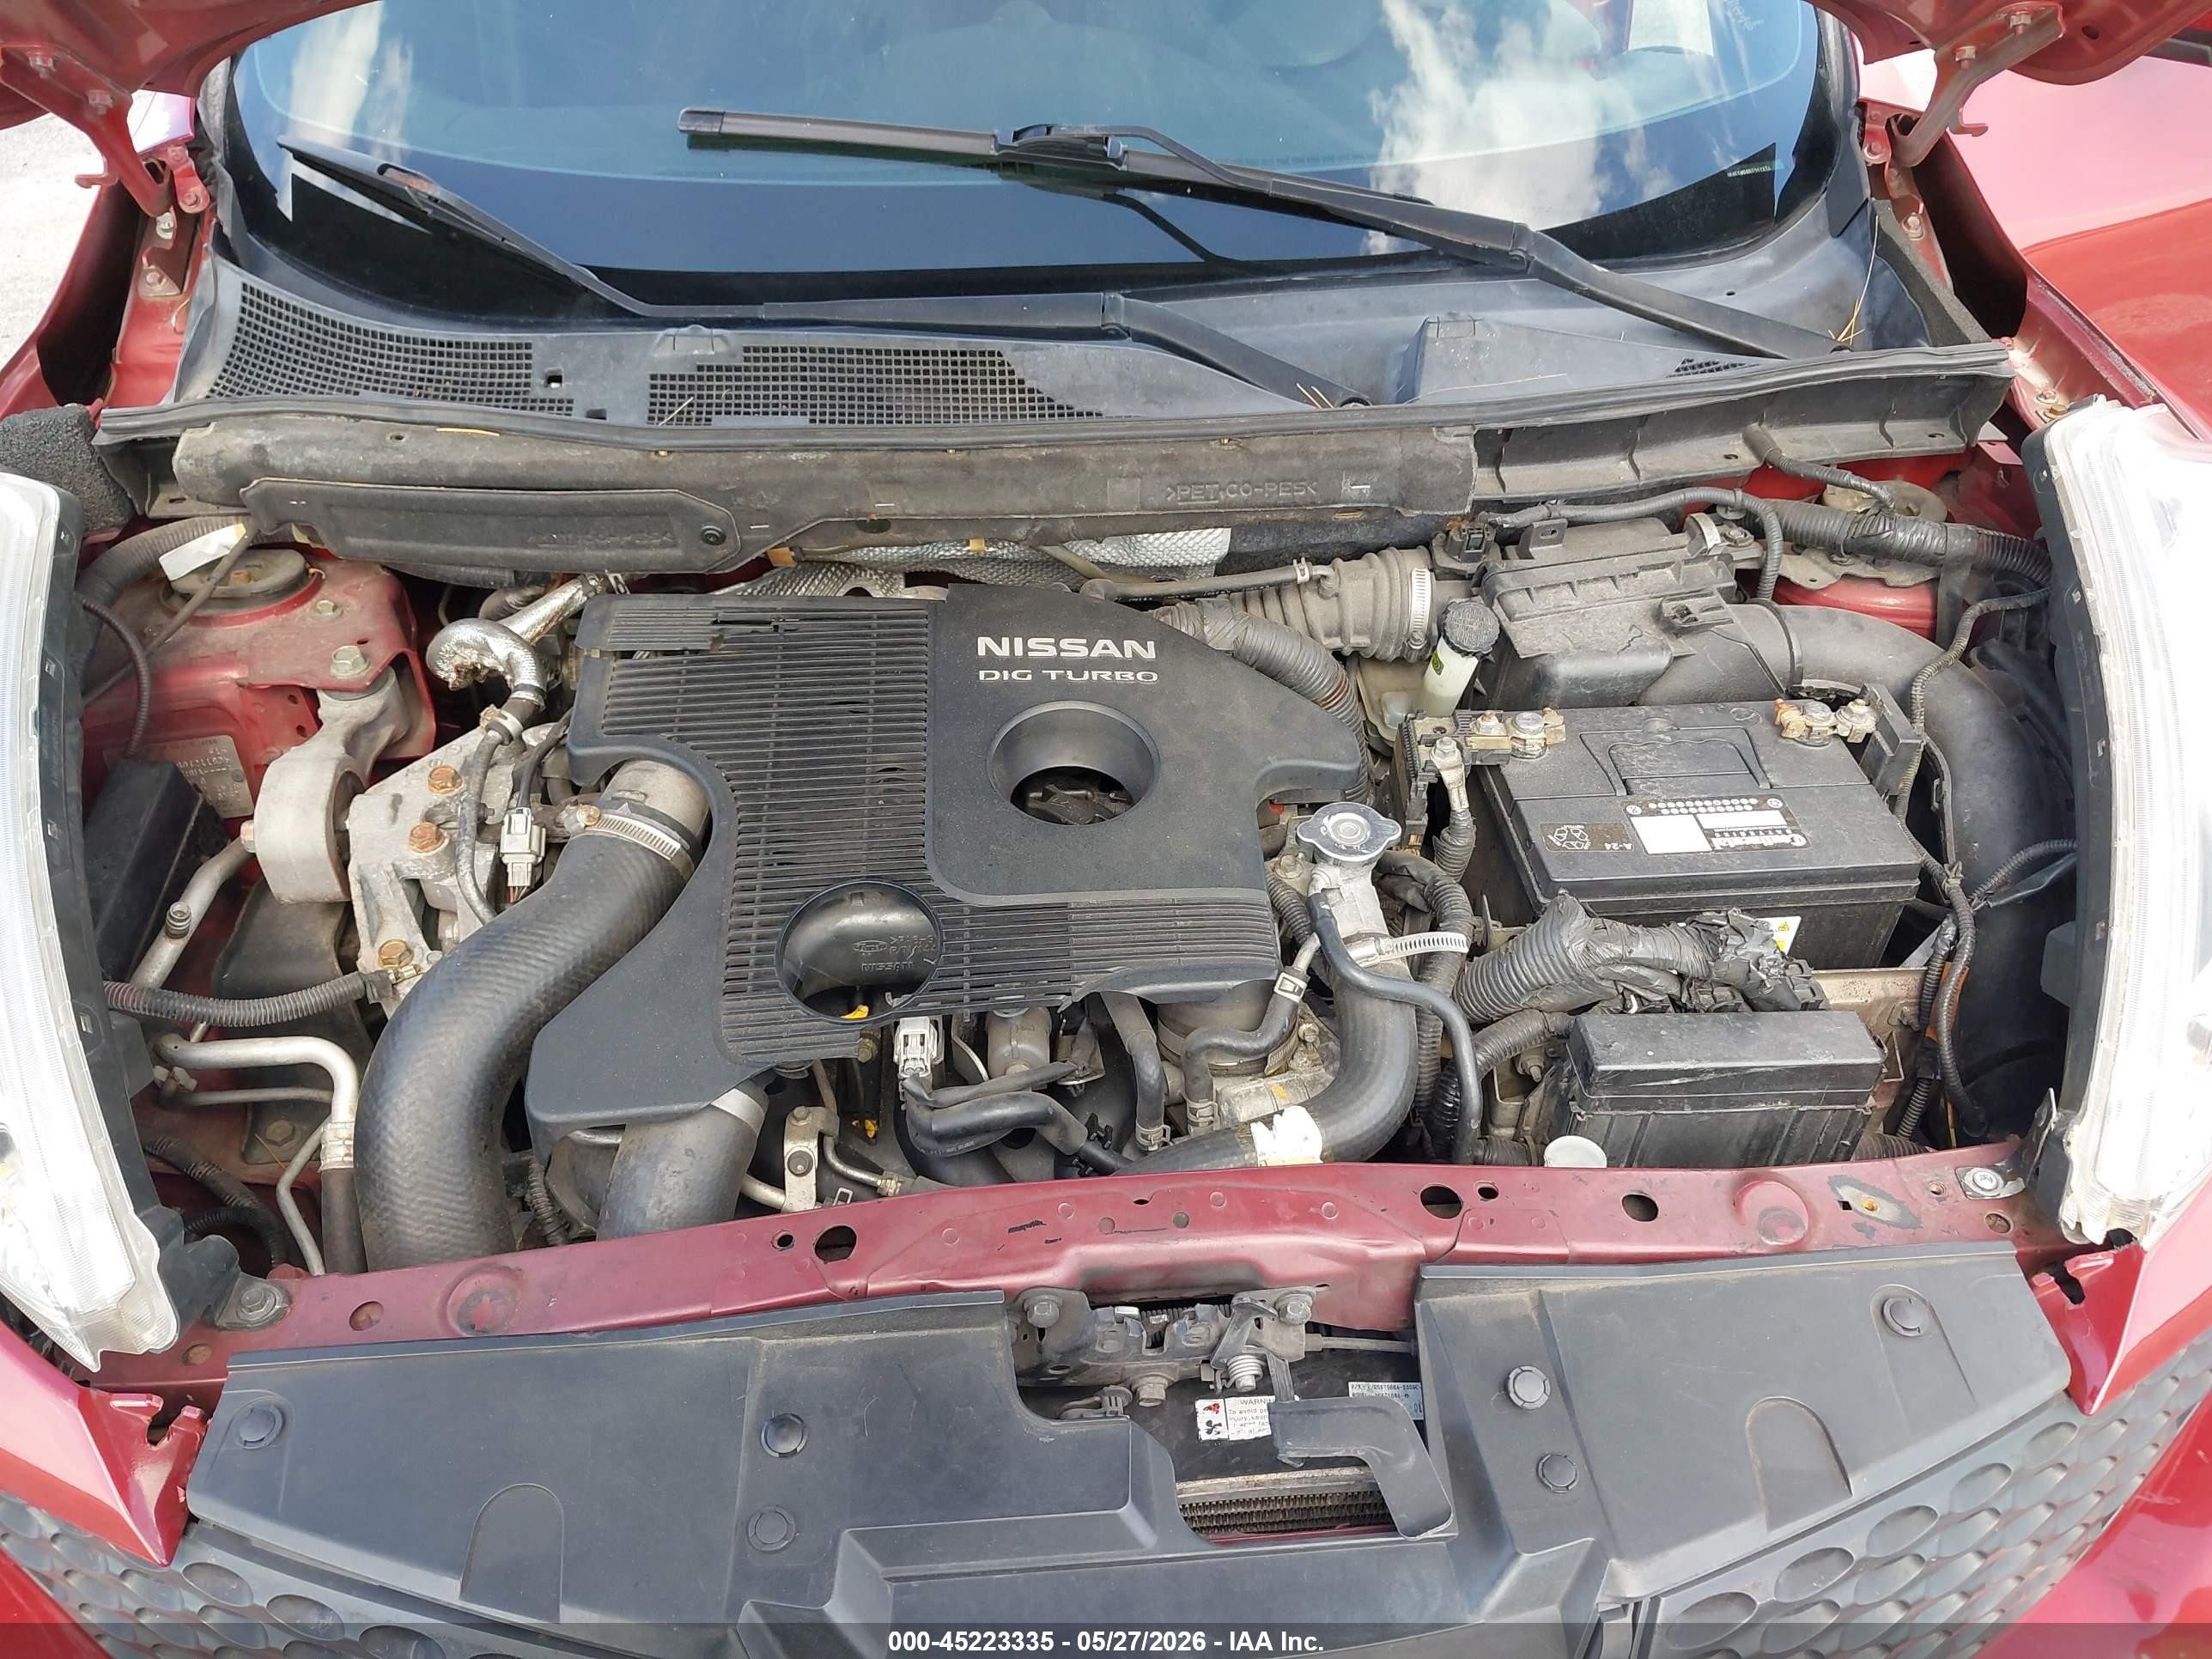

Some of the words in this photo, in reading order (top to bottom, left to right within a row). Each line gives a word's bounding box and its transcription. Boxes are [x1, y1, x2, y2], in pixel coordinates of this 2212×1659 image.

[977, 636, 1157, 659] NISSAN
[979, 670, 1032, 682] DIG
[1042, 670, 1158, 683] TURBO
[1604, 842, 1632, 850] A-24
[861, 962, 914, 972] NISSAN
